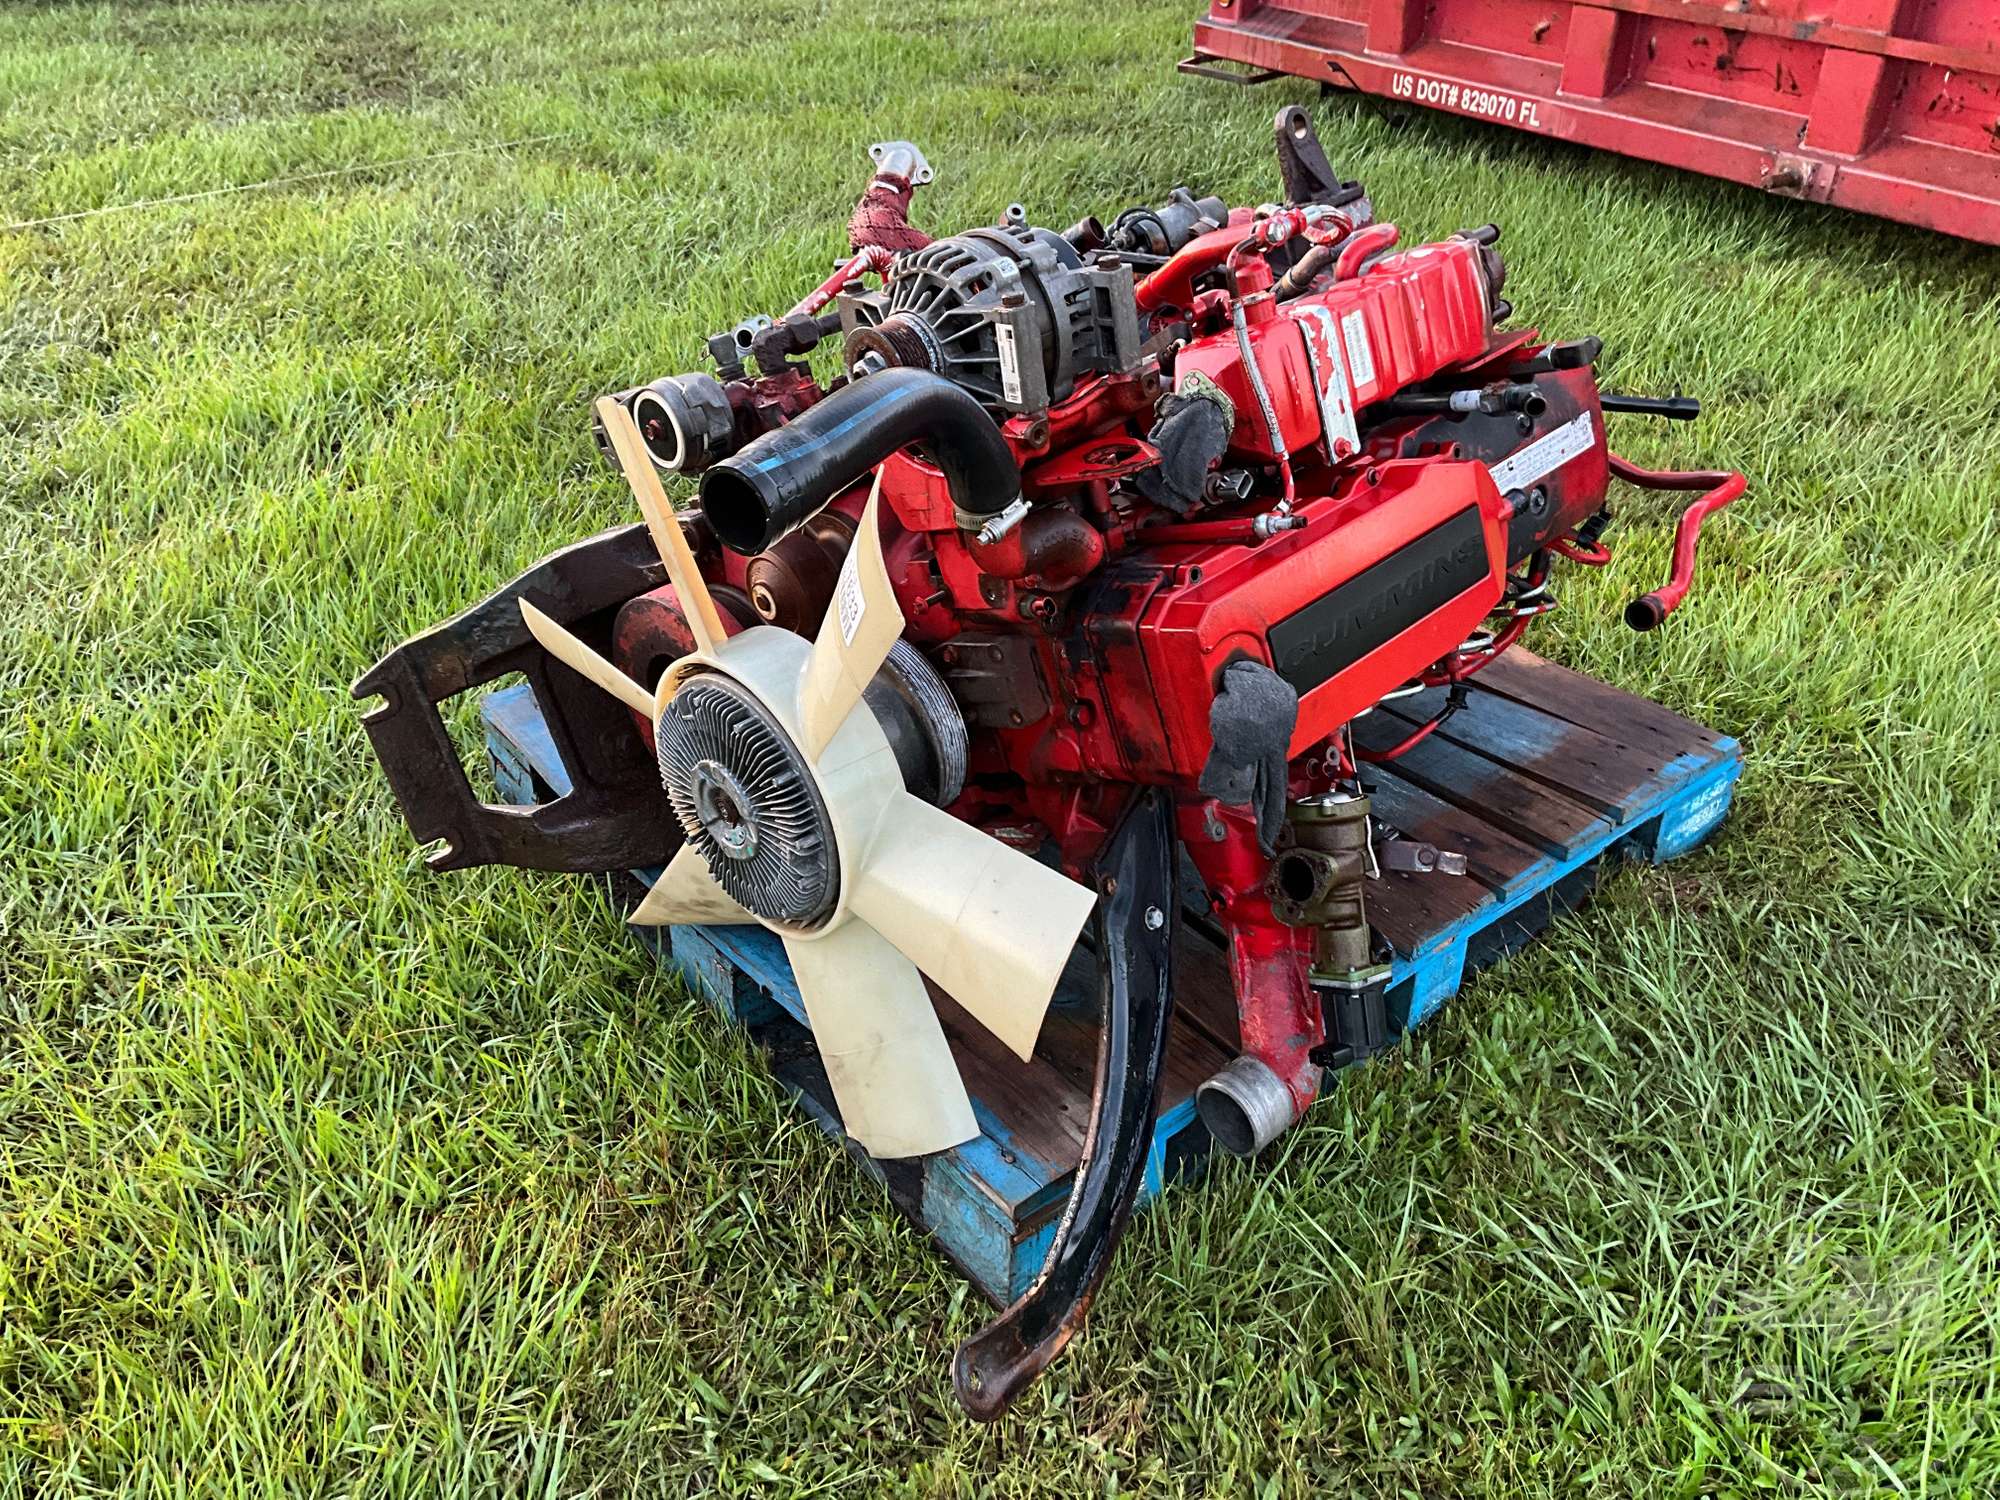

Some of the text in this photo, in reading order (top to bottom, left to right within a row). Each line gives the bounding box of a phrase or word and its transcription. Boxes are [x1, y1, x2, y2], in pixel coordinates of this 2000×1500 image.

[1392, 73, 1541, 127] US DOT# 829070 FL
[1279, 533, 1481, 674] CUMMINS
